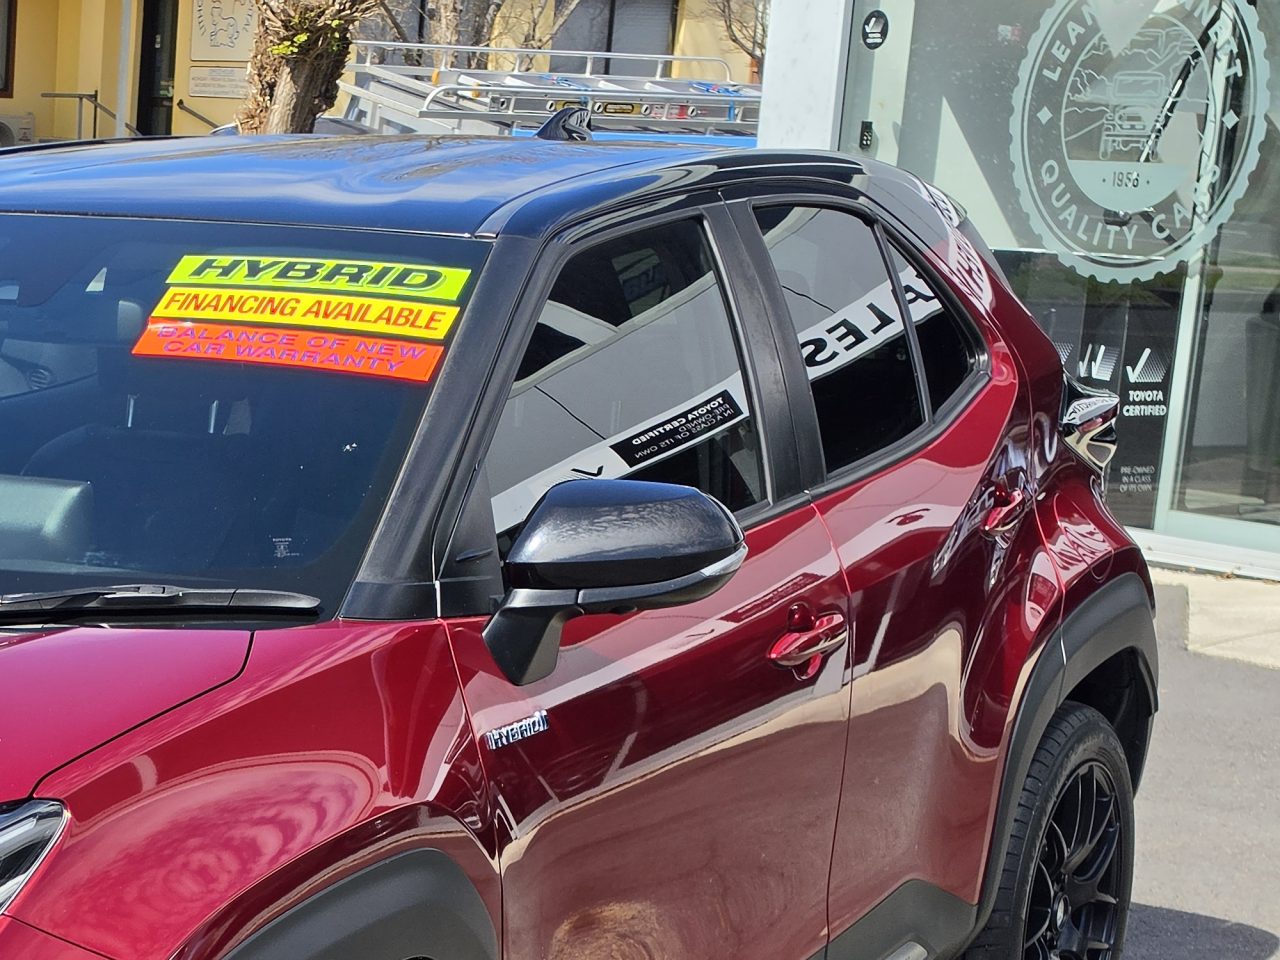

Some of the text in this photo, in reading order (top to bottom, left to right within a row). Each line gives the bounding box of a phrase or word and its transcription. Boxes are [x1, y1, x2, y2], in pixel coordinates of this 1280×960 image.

[1040, 159, 1139, 250] QUALITY
[188, 257, 446, 291] HYBRID
[163, 292, 447, 331] FINANCING AVAILABLE
[157, 325, 428, 360] BALANCE OF NEW
[163, 340, 406, 373] CAR WARRANTY
[1122, 405, 1167, 416] CERTIFIED
[1129, 390, 1163, 401] TOYOTA
